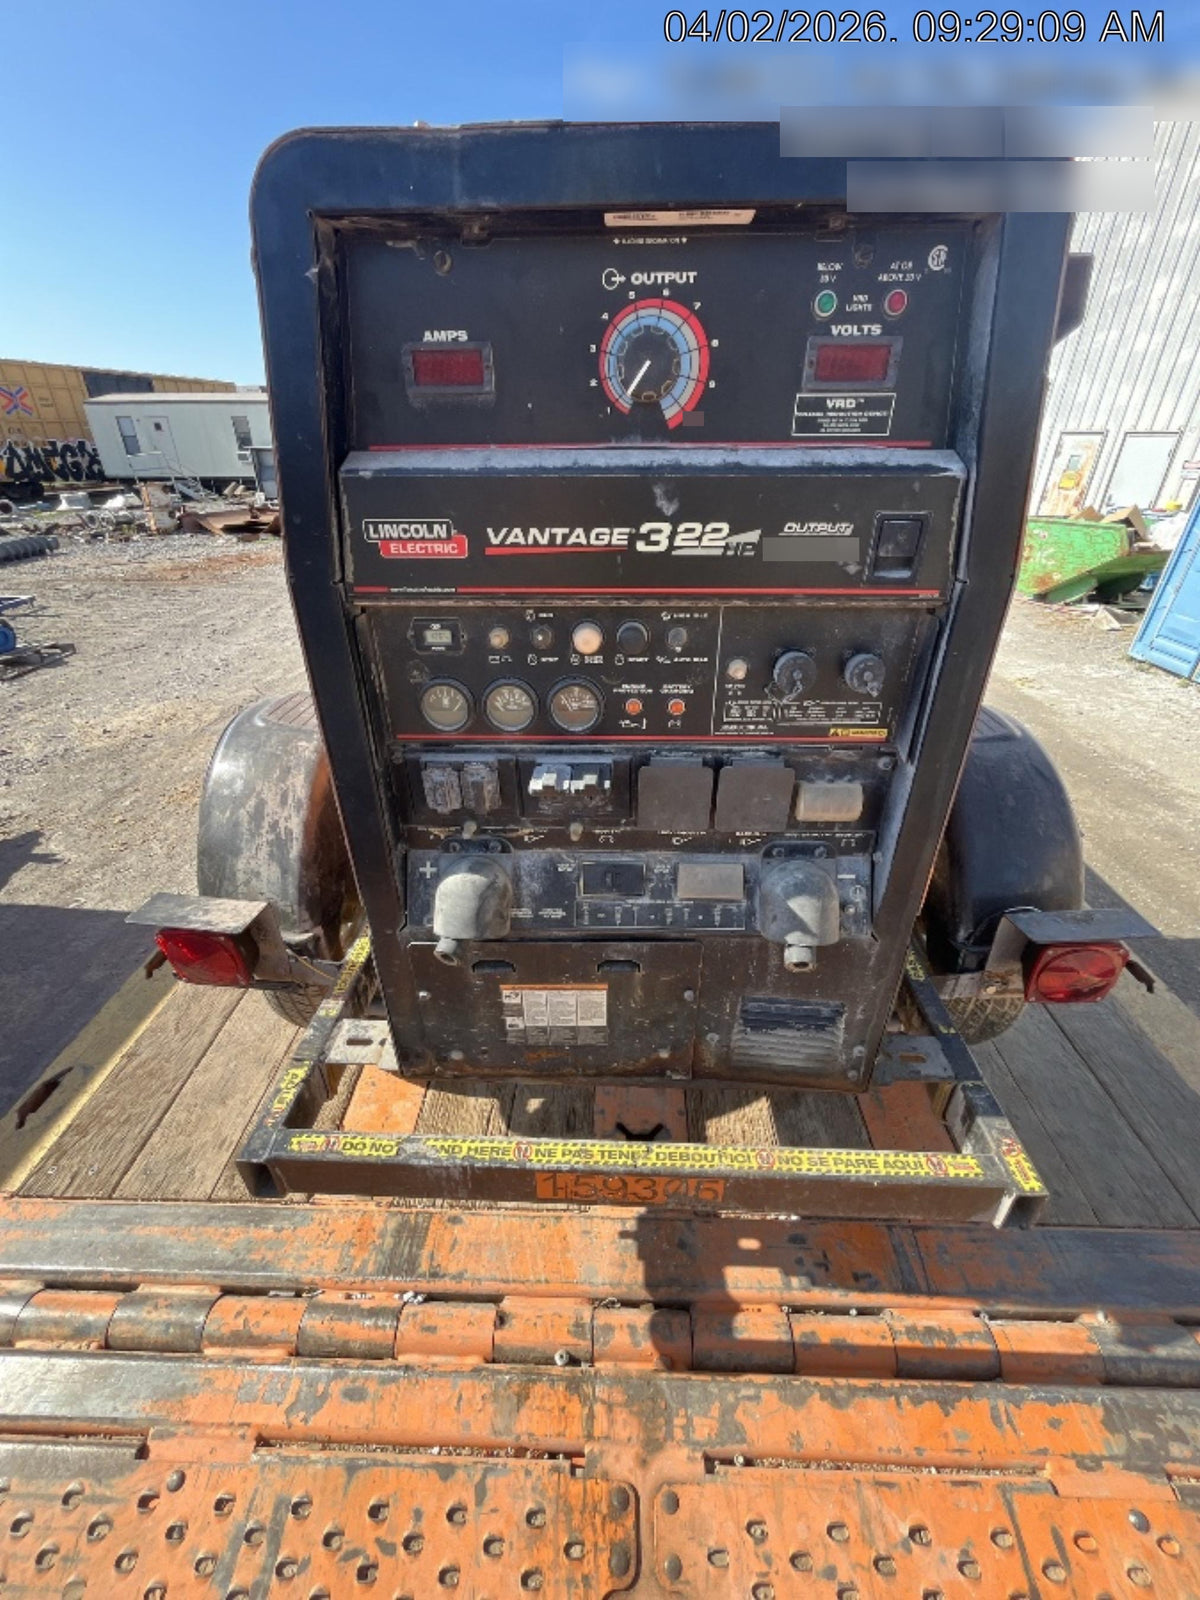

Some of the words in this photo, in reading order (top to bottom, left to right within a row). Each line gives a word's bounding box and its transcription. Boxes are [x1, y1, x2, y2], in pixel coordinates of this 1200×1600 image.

[630, 271, 697, 285] OUTPUT
[693, 302, 701, 310] 7
[422, 330, 468, 342] AMPS
[830, 324, 882, 336] VOLTS
[369, 524, 448, 539] LINCOLN
[783, 522, 846, 532] OUTPUT
[486, 527, 629, 545] VANTAGE
[635, 522, 730, 552] 322
[390, 543, 458, 554] ELECTRIC
[343, 1140, 367, 1151] DO
[369, 1142, 399, 1153] NO
[467, 1146, 513, 1157] HERE
[535, 1148, 556, 1158] NE
[561, 1149, 594, 1161] PAS
[777, 1155, 803, 1166] NO
[806, 1157, 829, 1167] SE
[832, 1157, 880, 1169] PARE
